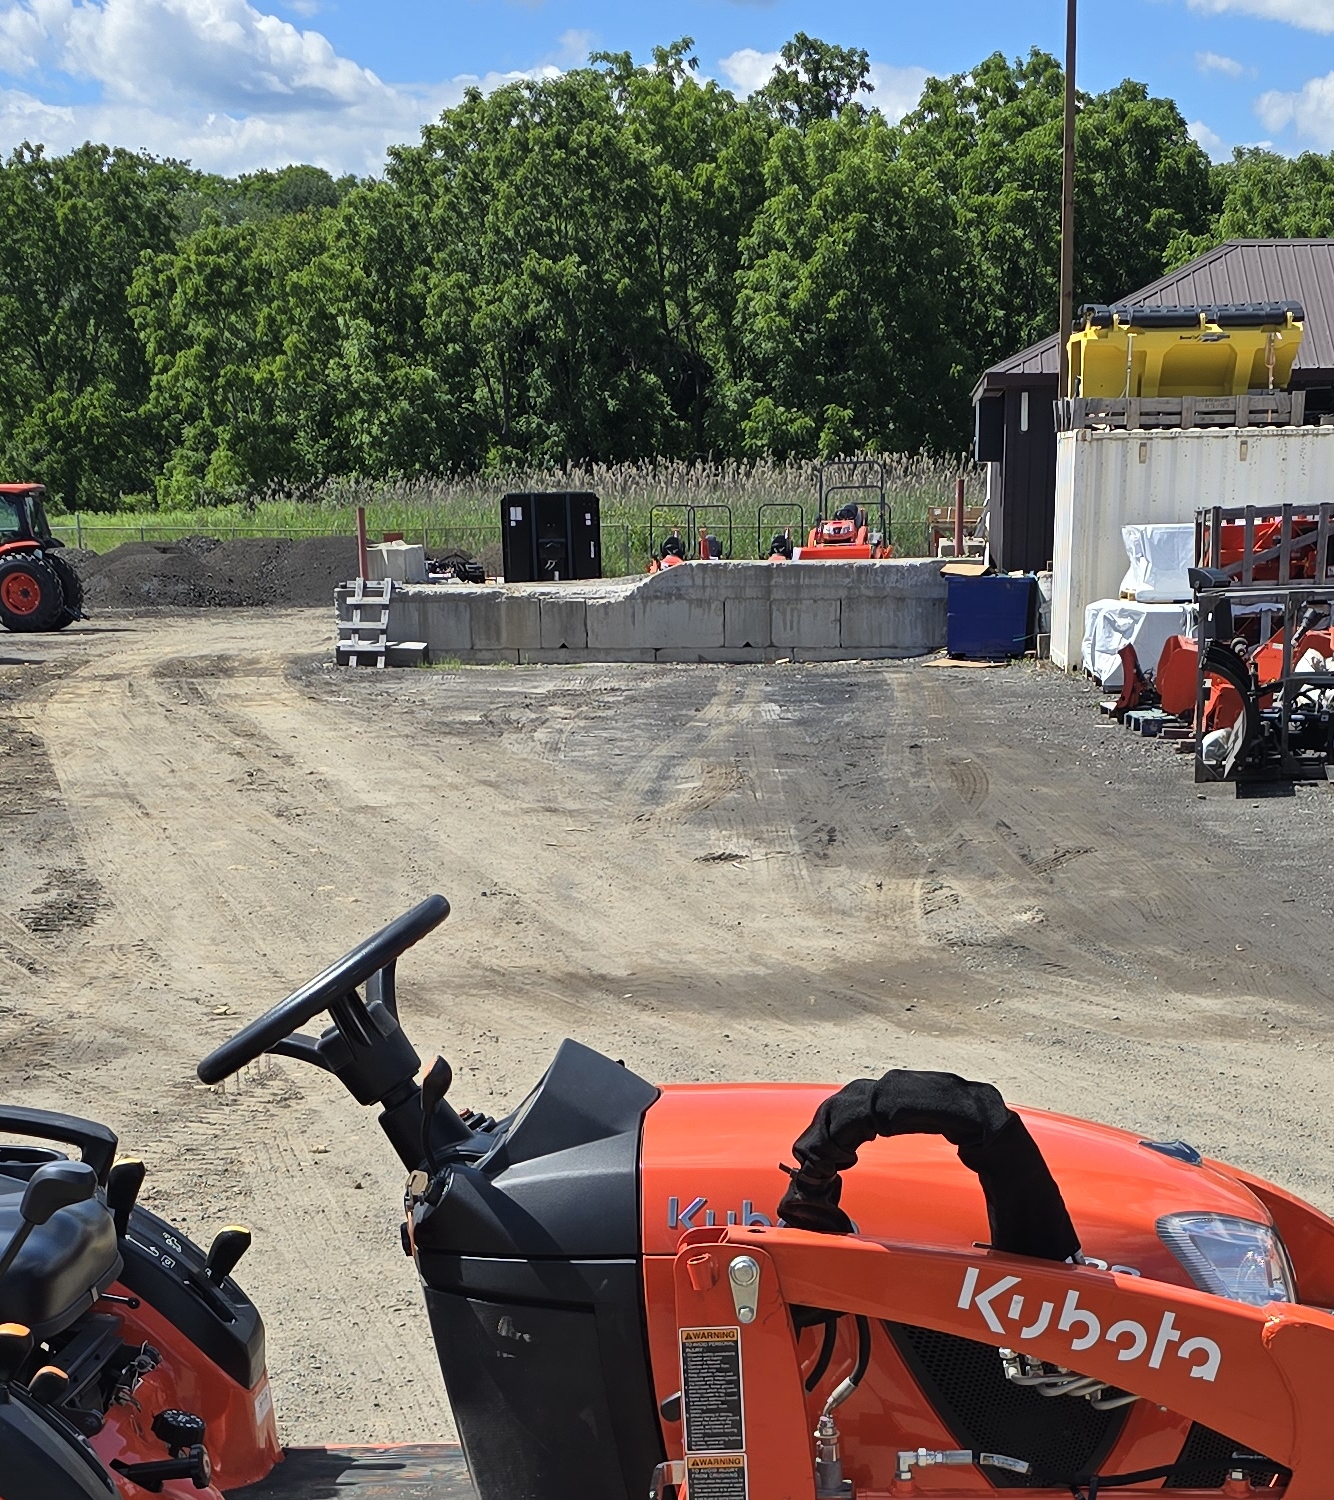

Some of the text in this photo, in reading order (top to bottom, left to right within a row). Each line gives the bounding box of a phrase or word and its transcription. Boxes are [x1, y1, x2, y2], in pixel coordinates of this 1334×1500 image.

[957, 1266, 1222, 1382] Kubota
[692, 1331, 735, 1340] WARNING
[699, 1457, 741, 1466] WARNING
